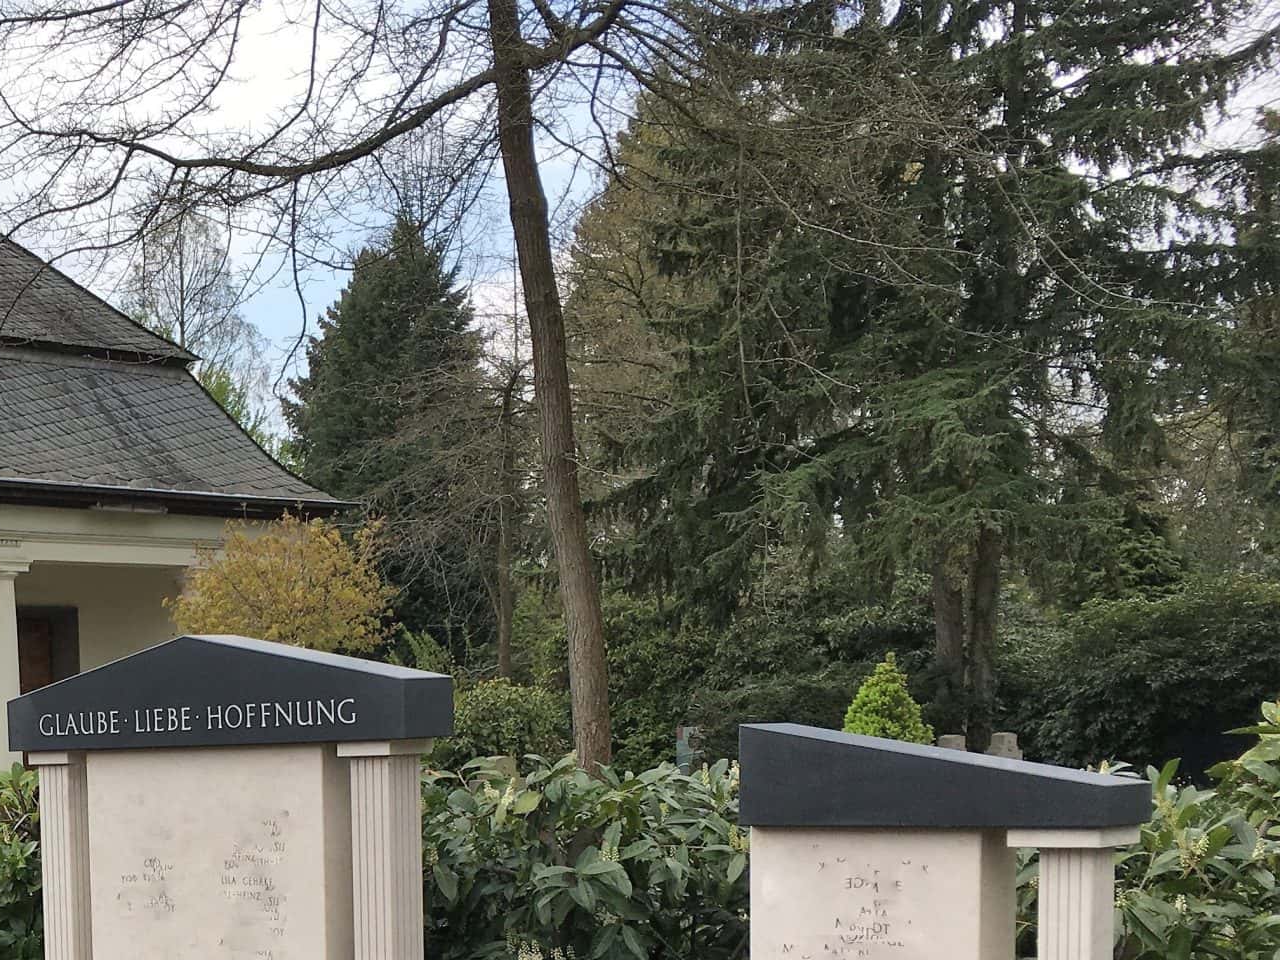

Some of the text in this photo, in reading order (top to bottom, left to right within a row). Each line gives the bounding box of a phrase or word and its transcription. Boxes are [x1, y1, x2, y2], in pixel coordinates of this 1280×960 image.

[39, 698, 357, 737] GLAUBE LIEBE HOFFNUNG
